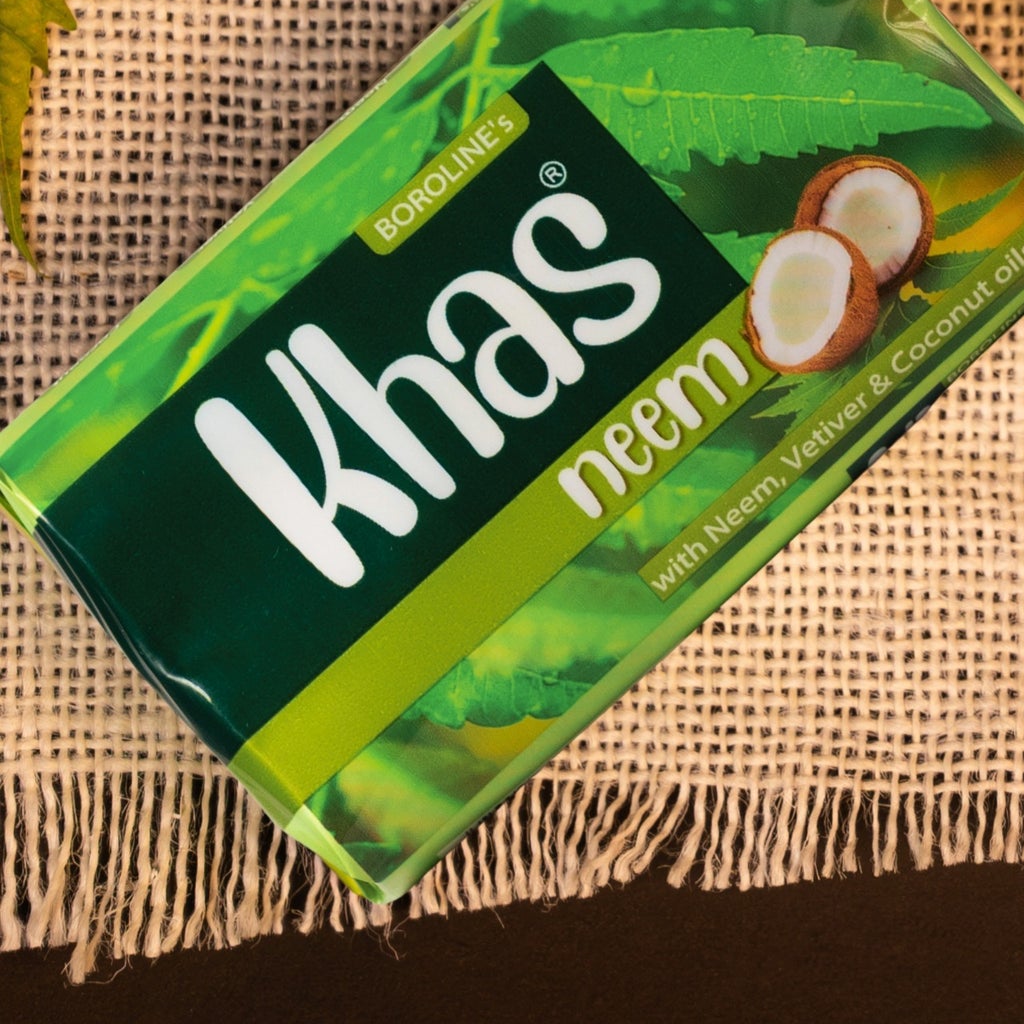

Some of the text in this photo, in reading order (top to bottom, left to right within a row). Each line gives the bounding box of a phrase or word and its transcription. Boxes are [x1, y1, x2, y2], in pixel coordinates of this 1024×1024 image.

[374, 114, 515, 242] BOROLINE's
[557, 338, 749, 519] neem
[651, 541, 708, 592] with
[703, 472, 787, 543] Neem,
[780, 391, 872, 470] Vetiver
[869, 374, 893, 395] &
[891, 280, 995, 374] Coconut
